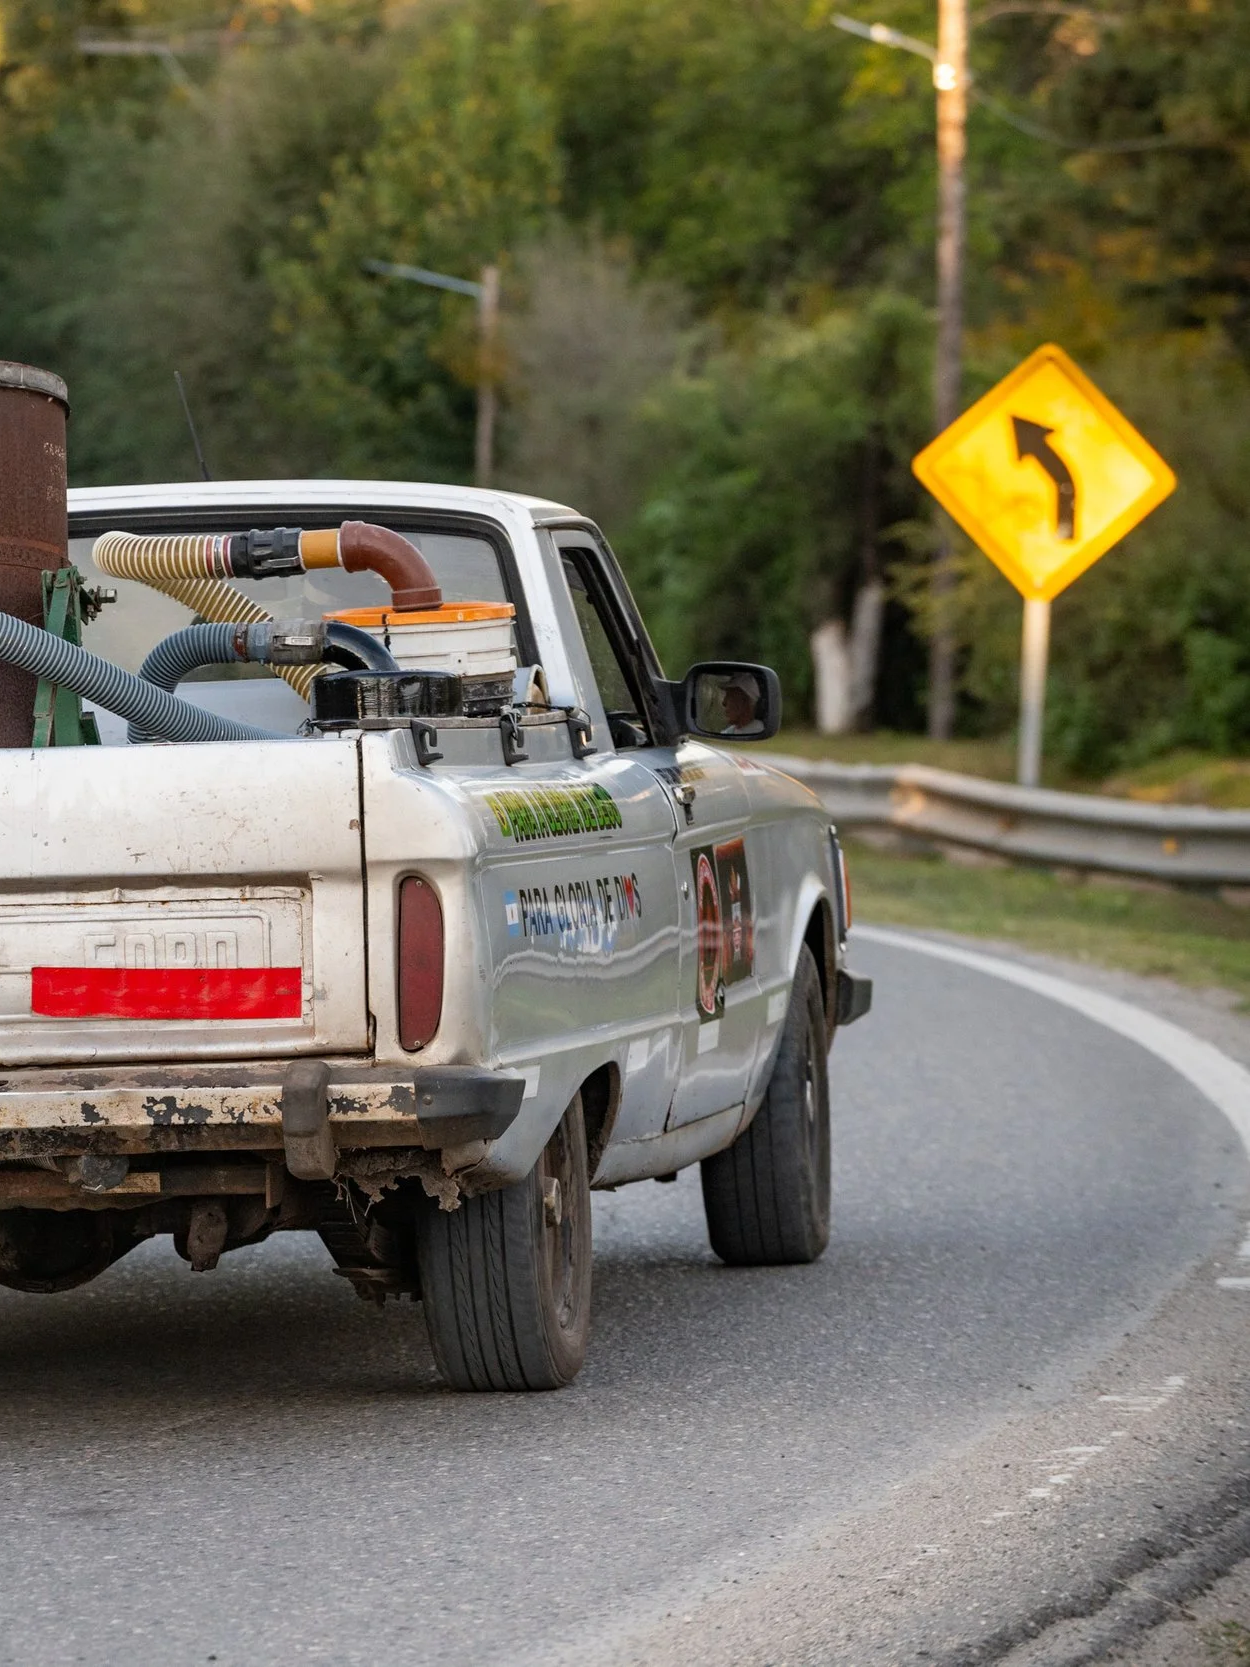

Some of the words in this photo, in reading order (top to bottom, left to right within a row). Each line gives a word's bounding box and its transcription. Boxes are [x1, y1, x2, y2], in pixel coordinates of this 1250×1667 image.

[518, 887, 554, 937] PARA
[554, 880, 598, 932] GLORIA
[596, 877, 615, 924] DE
